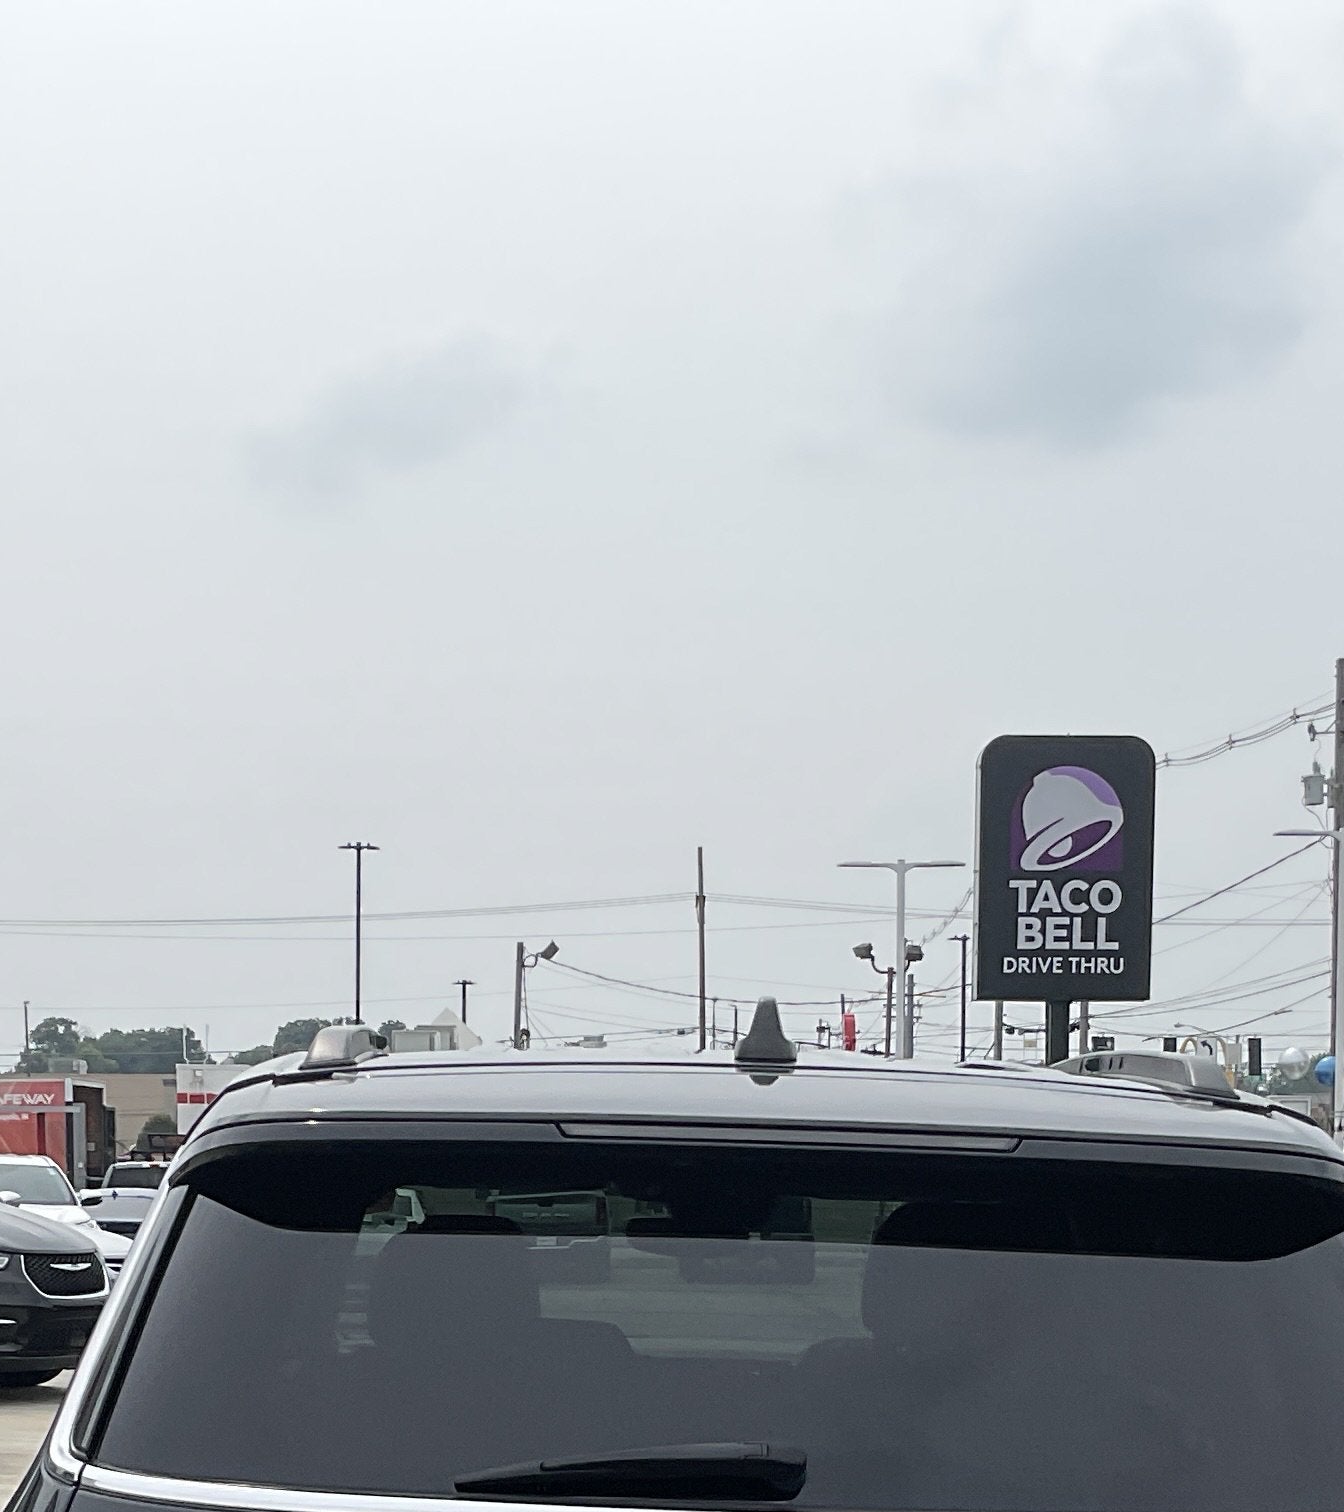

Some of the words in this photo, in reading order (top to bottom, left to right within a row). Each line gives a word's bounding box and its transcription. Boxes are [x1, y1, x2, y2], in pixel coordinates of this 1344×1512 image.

[1008, 879, 1123, 914] TACO
[1016, 916, 1119, 950] BELL
[1002, 957, 1064, 974] DRIVE
[1068, 957, 1124, 974] THRU
